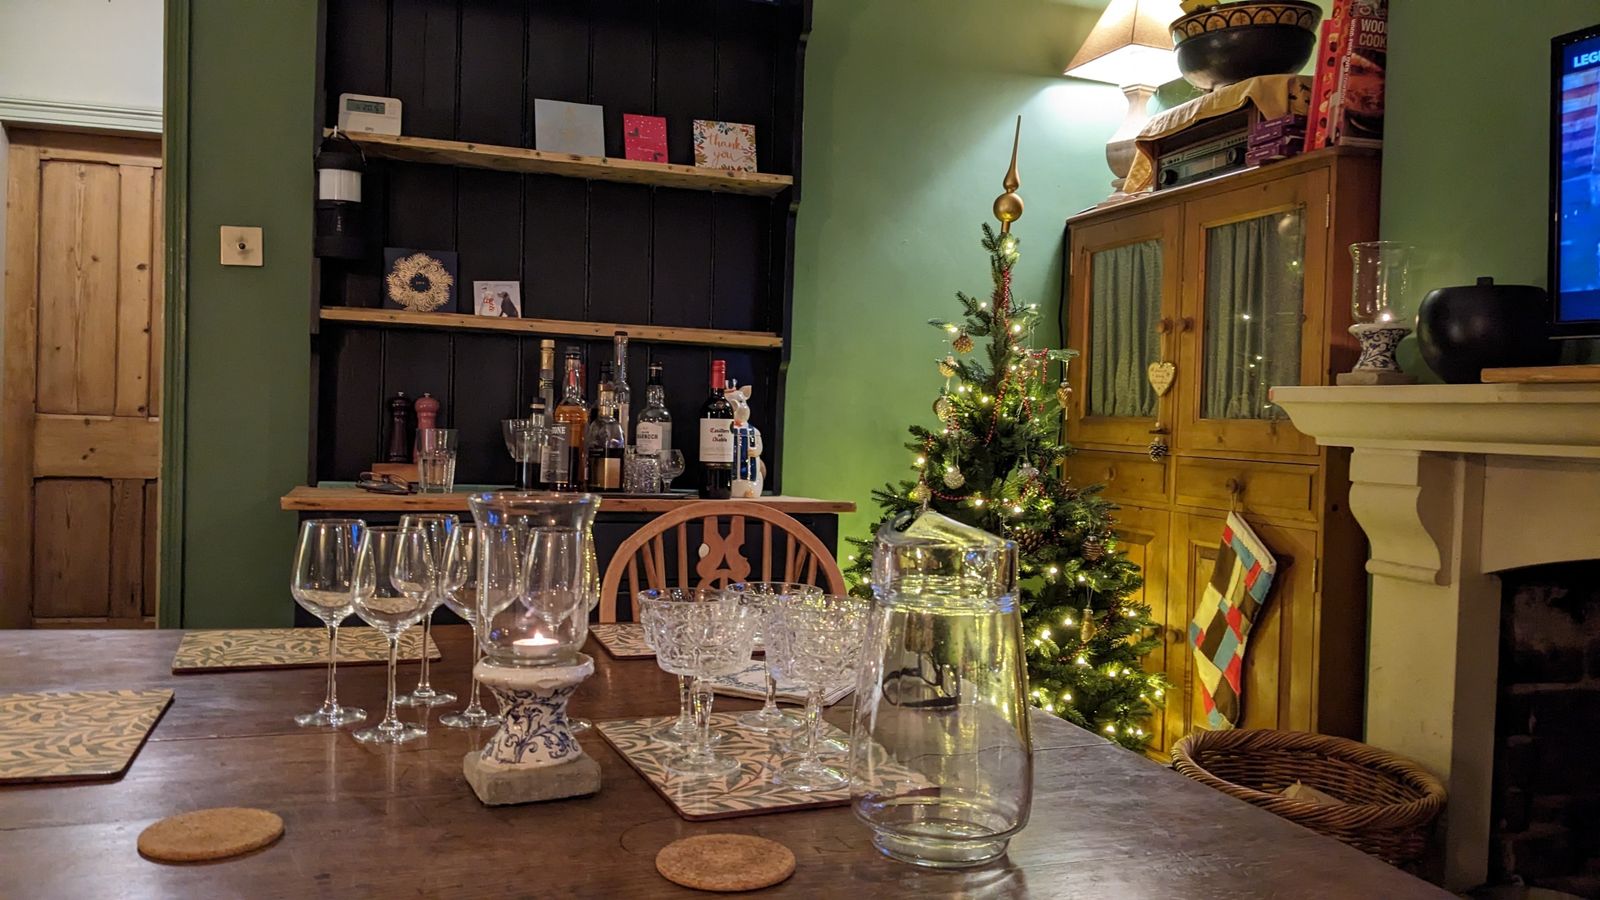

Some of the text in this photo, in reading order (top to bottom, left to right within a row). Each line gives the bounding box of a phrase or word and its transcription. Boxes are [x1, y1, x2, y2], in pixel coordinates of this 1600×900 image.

[1573, 50, 1600, 68] LEG
[708, 132, 741, 150] thank
[712, 151, 734, 167] you
